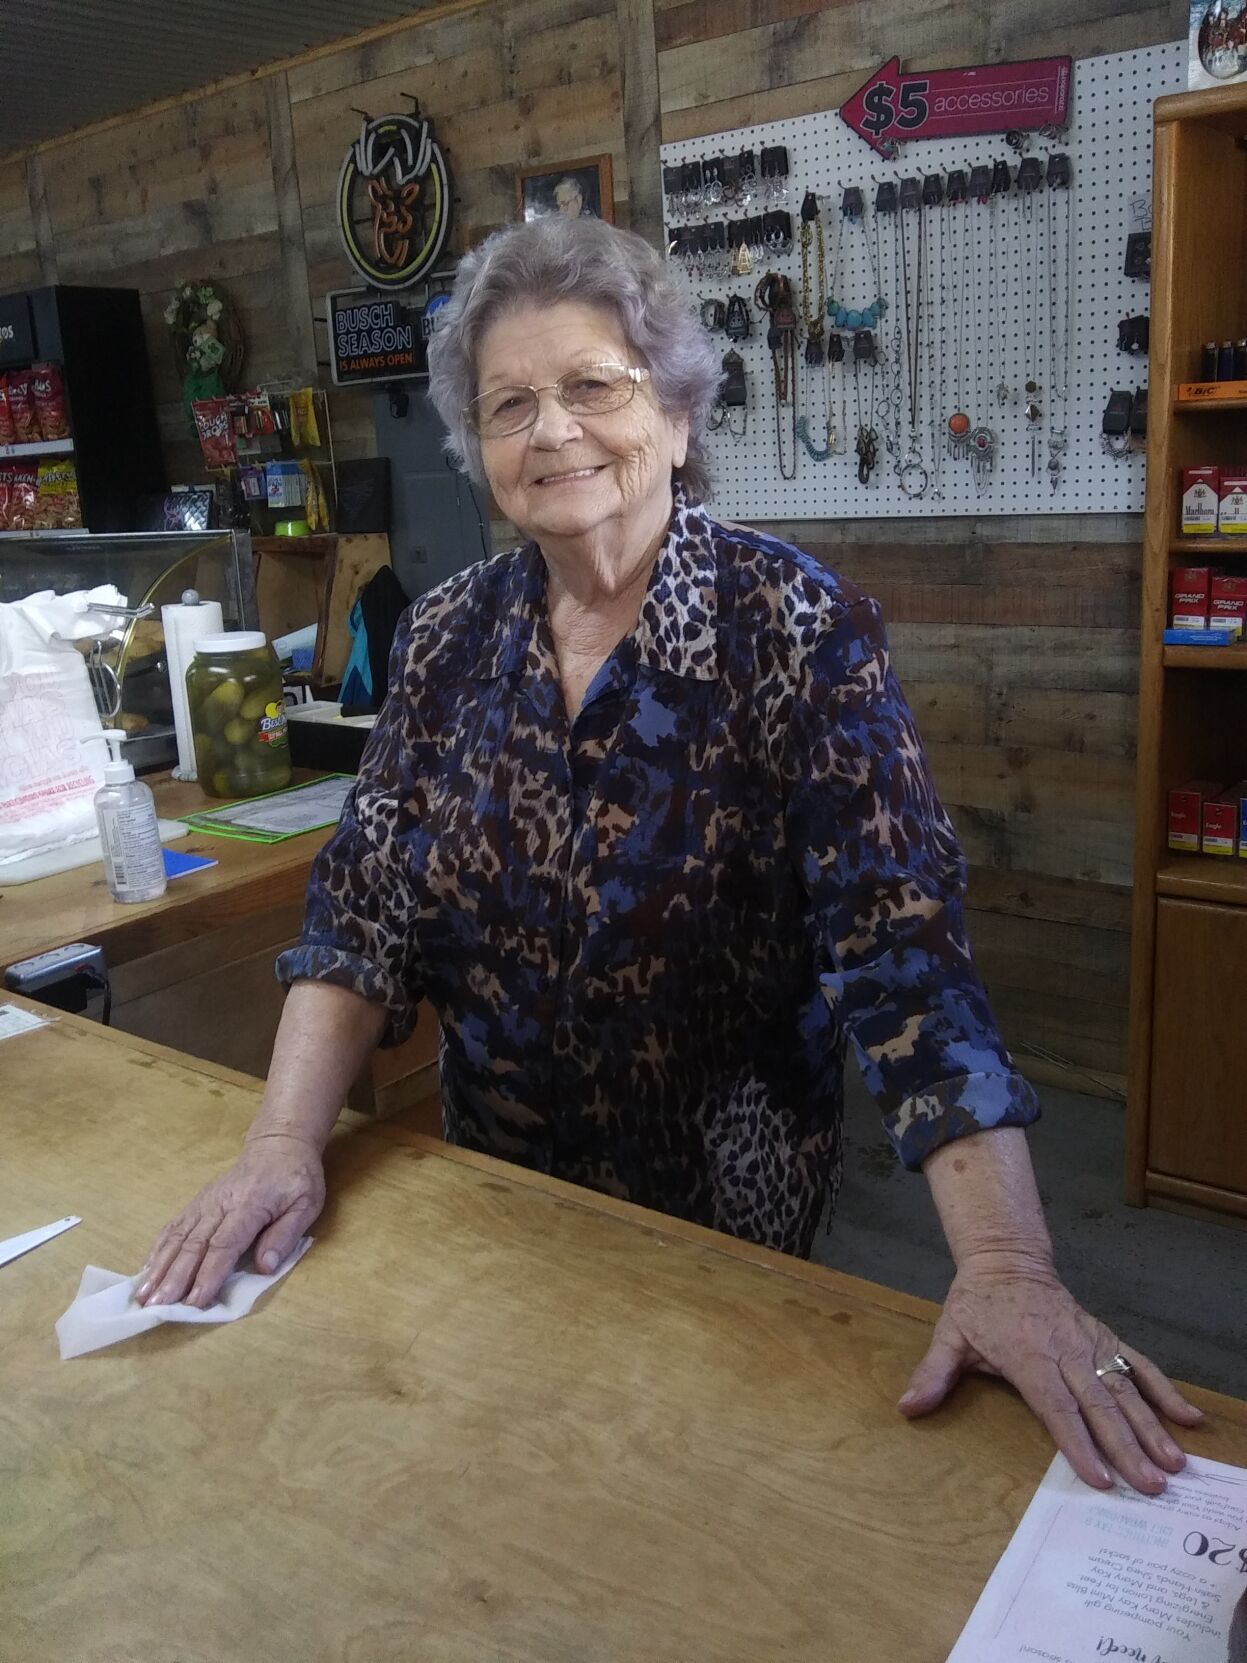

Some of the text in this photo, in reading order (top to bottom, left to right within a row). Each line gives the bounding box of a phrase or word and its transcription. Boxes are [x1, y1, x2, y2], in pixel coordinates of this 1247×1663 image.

[860, 80, 930, 138] $5
[934, 85, 1050, 112] accessories
[336, 303, 394, 334] BUSCH
[337, 326, 412, 357] SEASON
[340, 352, 413, 371] IS ALWAYS OPEN
[1213, 599, 1244, 607] GRAND
[1087, 1555, 1123, 1571] Cream
[1090, 1566, 1111, 1579] Kay
[1117, 1575, 1144, 1589] Mary
[1146, 1582, 1168, 1594] and
[1156, 1574, 1192, 1592] Hands
[1079, 1574, 1214, 1624] Energizing Lotion for Feet
[1089, 1588, 1116, 1603] Mint
[1194, 1587, 1222, 1602] Satin
[1118, 1597, 1139, 1610] Kay
[1103, 1603, 1164, 1628] pampering
[1142, 1603, 1173, 1621] Mary
[1166, 1625, 1191, 1641] Your
